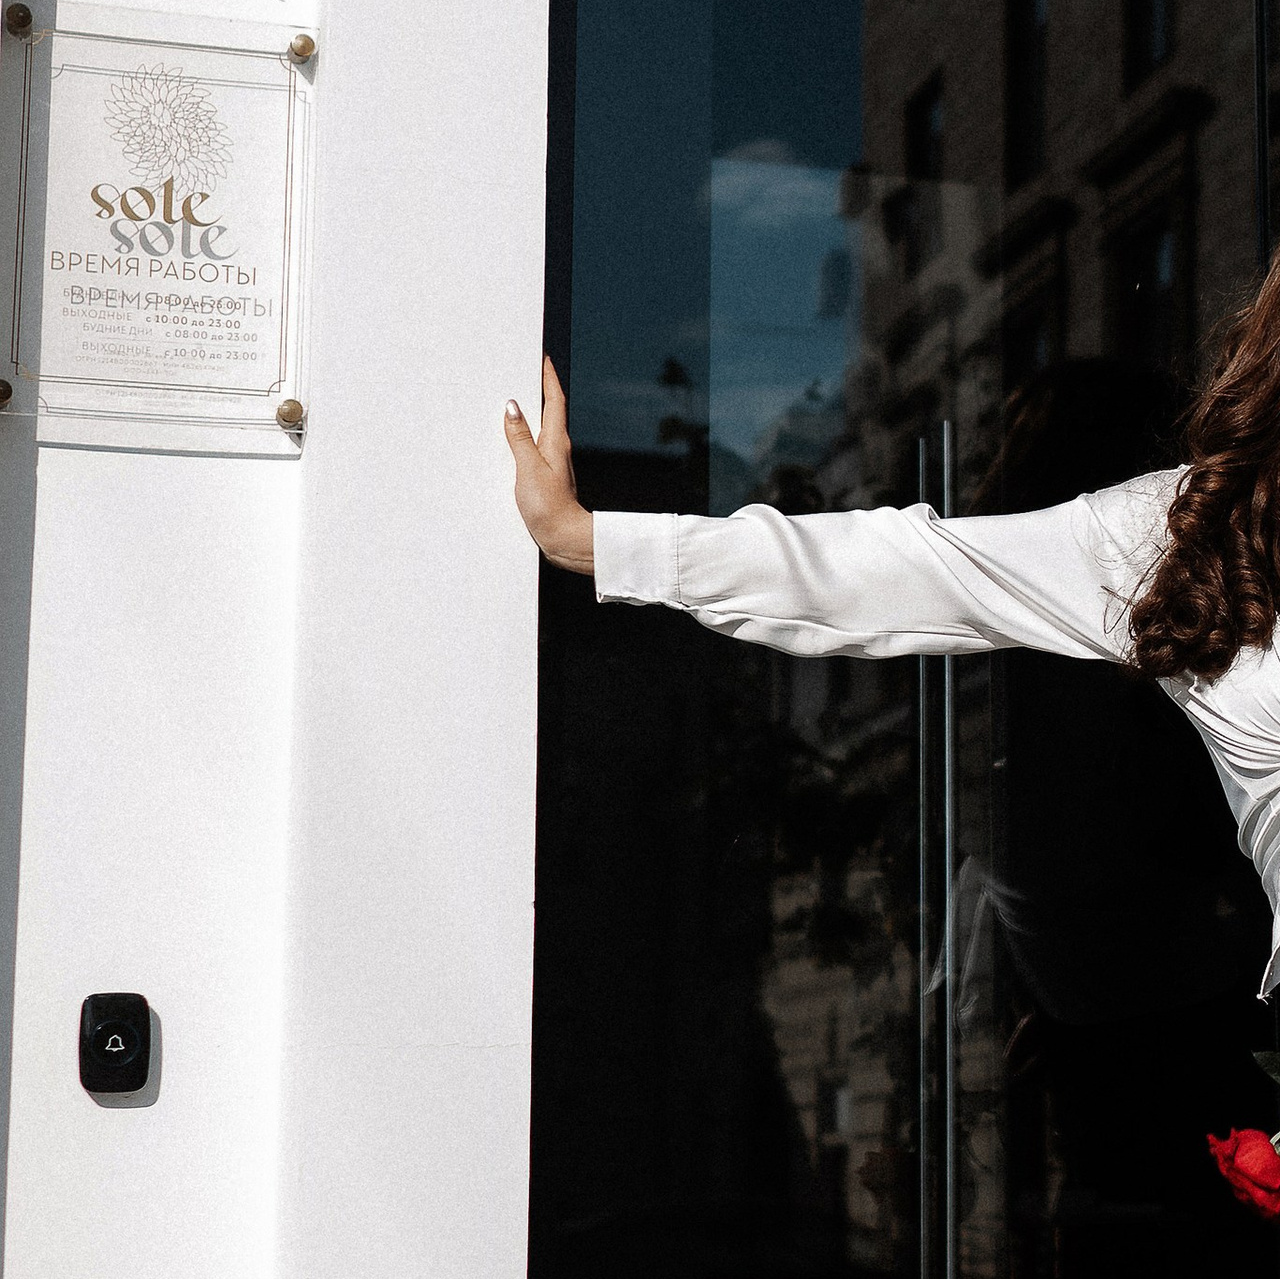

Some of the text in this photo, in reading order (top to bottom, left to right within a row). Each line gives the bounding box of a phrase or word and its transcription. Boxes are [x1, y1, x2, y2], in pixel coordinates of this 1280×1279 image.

[50, 250, 257, 286] ВРЕМЯ РАБОТЫ
[62, 307, 132, 321] ВЫХОДНЫЕ
[154, 314, 188, 325] 10:00
[191, 319, 205, 328] до
[208, 318, 241, 329] 23:00
[82, 322, 127, 335] БУДНИЕ
[128, 324, 153, 336] ДНИ
[174, 329, 208, 340] 08:00
[210, 333, 224, 341] до
[82, 341, 151, 356] ВЫХОДНЫЕ
